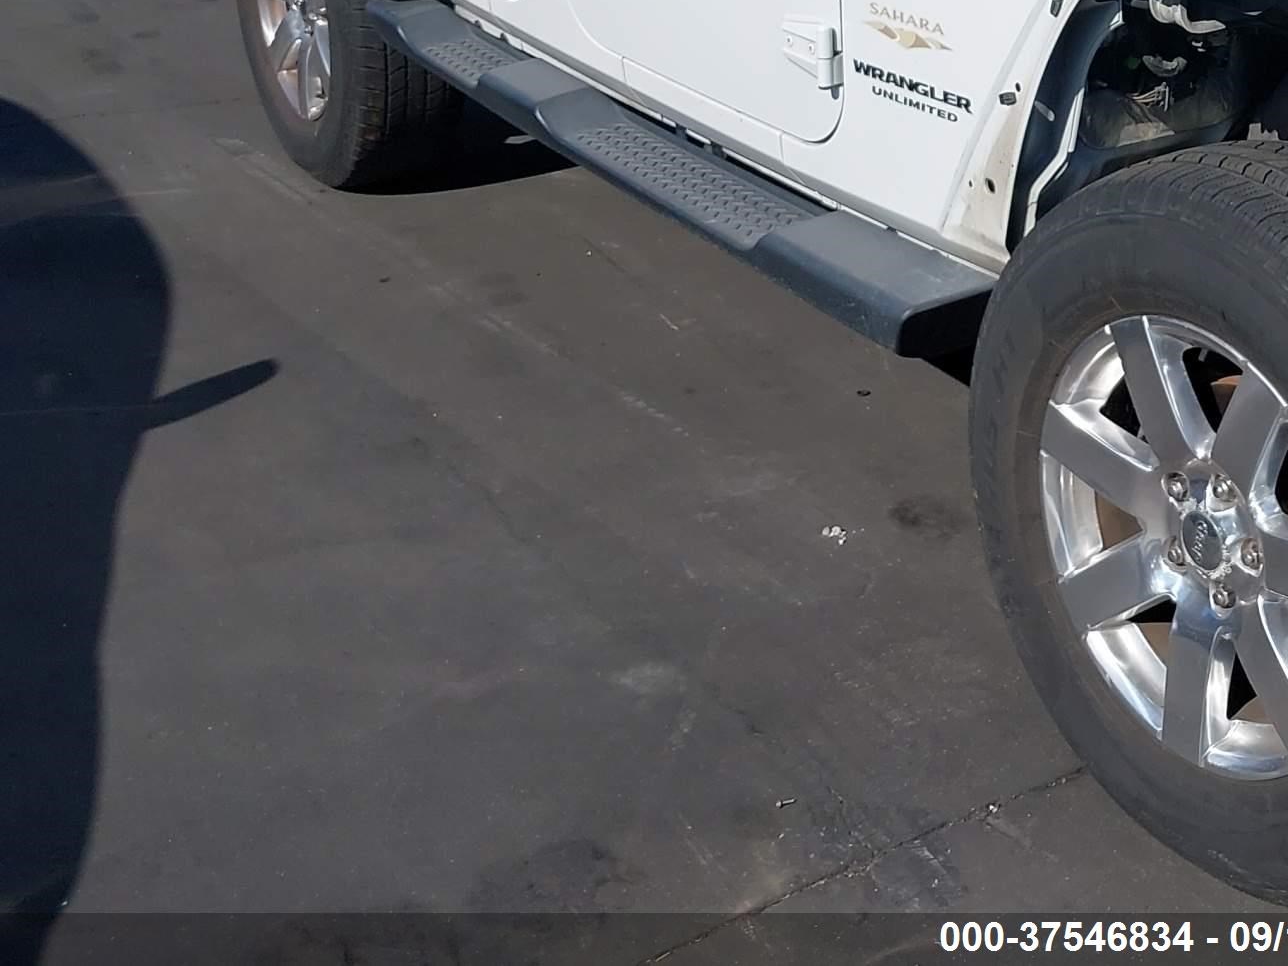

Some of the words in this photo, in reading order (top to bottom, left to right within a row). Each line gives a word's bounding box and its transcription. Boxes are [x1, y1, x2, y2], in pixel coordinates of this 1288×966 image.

[869, 2, 945, 36] SAHARA
[852, 57, 973, 115] WRANGLER
[871, 85, 958, 123] UNLIMITED
